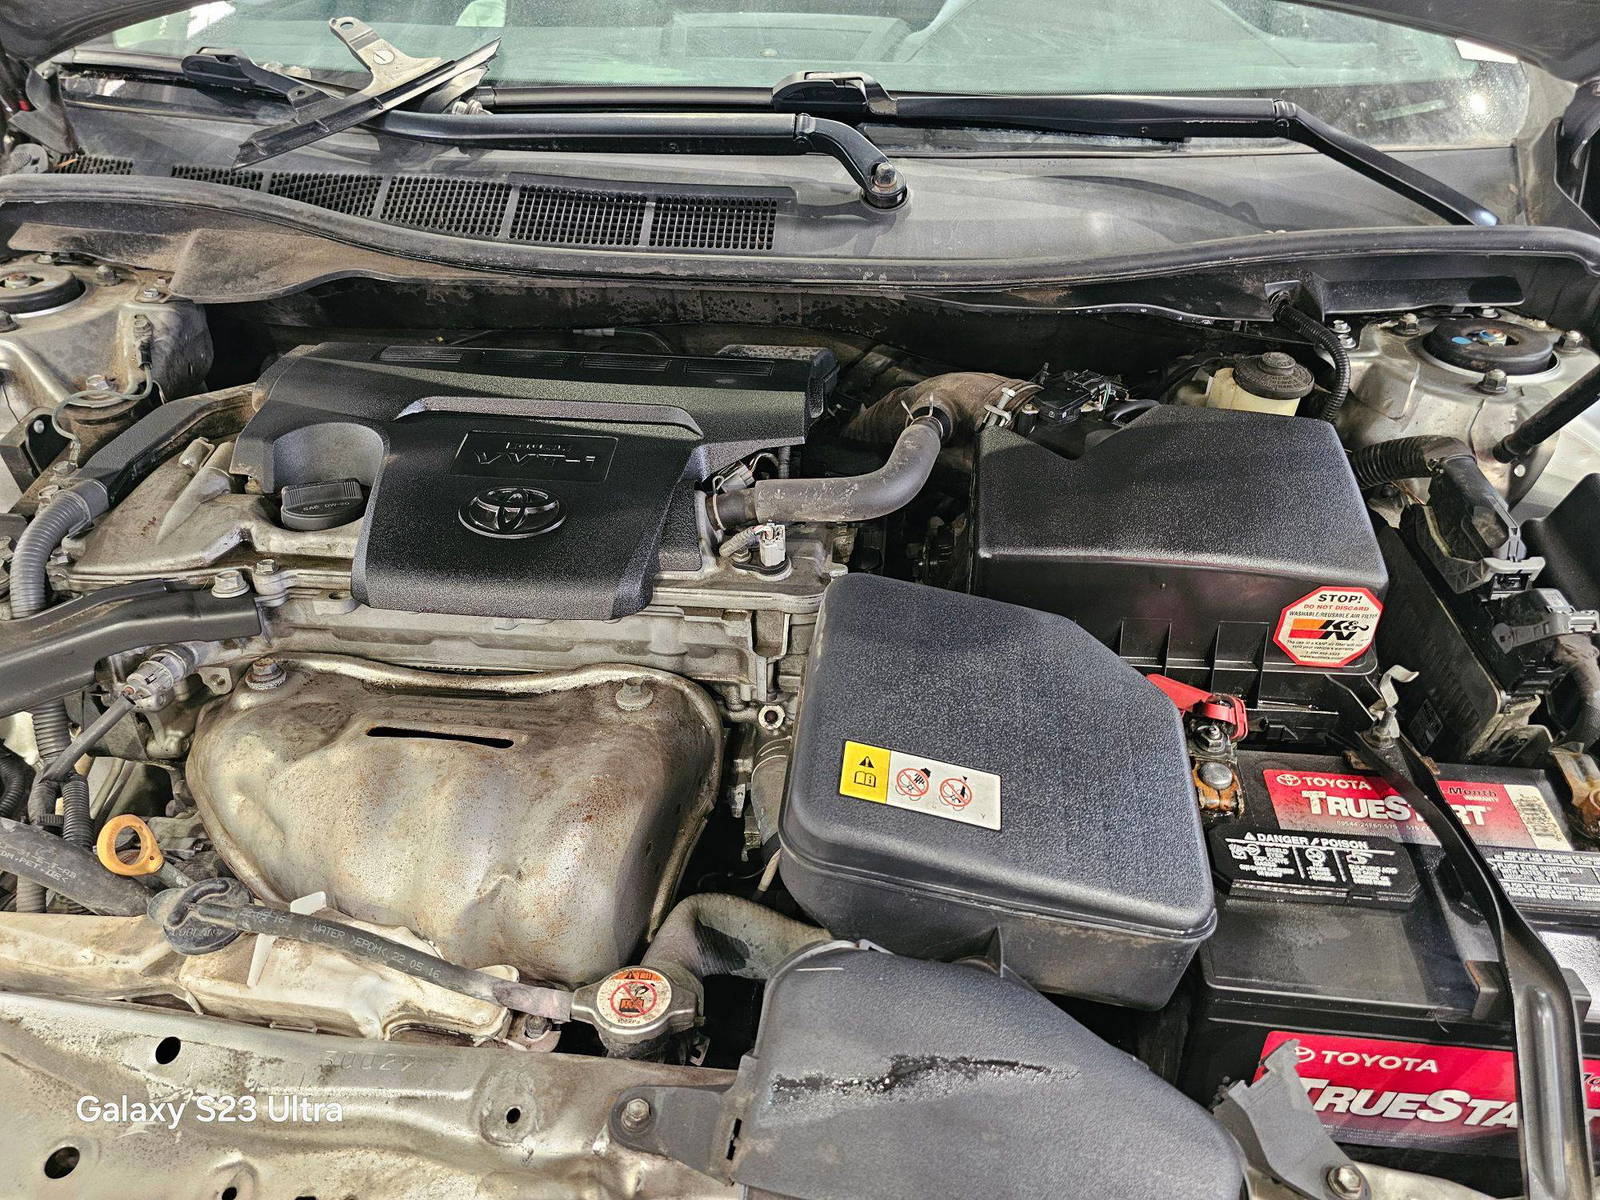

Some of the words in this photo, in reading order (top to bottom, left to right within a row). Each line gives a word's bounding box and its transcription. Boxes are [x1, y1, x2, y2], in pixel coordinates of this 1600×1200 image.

[1318, 594, 1363, 604] STOP!
[1302, 776, 1372, 790] TOYOTA
[1449, 786, 1498, 798] Month
[1256, 833, 1309, 846] DANGER
[1321, 838, 1369, 850] POISON
[312, 923, 346, 939] WATER
[1320, 1050, 1439, 1073] TOYOTA
[1299, 1077, 1518, 1129] TRUESTA
